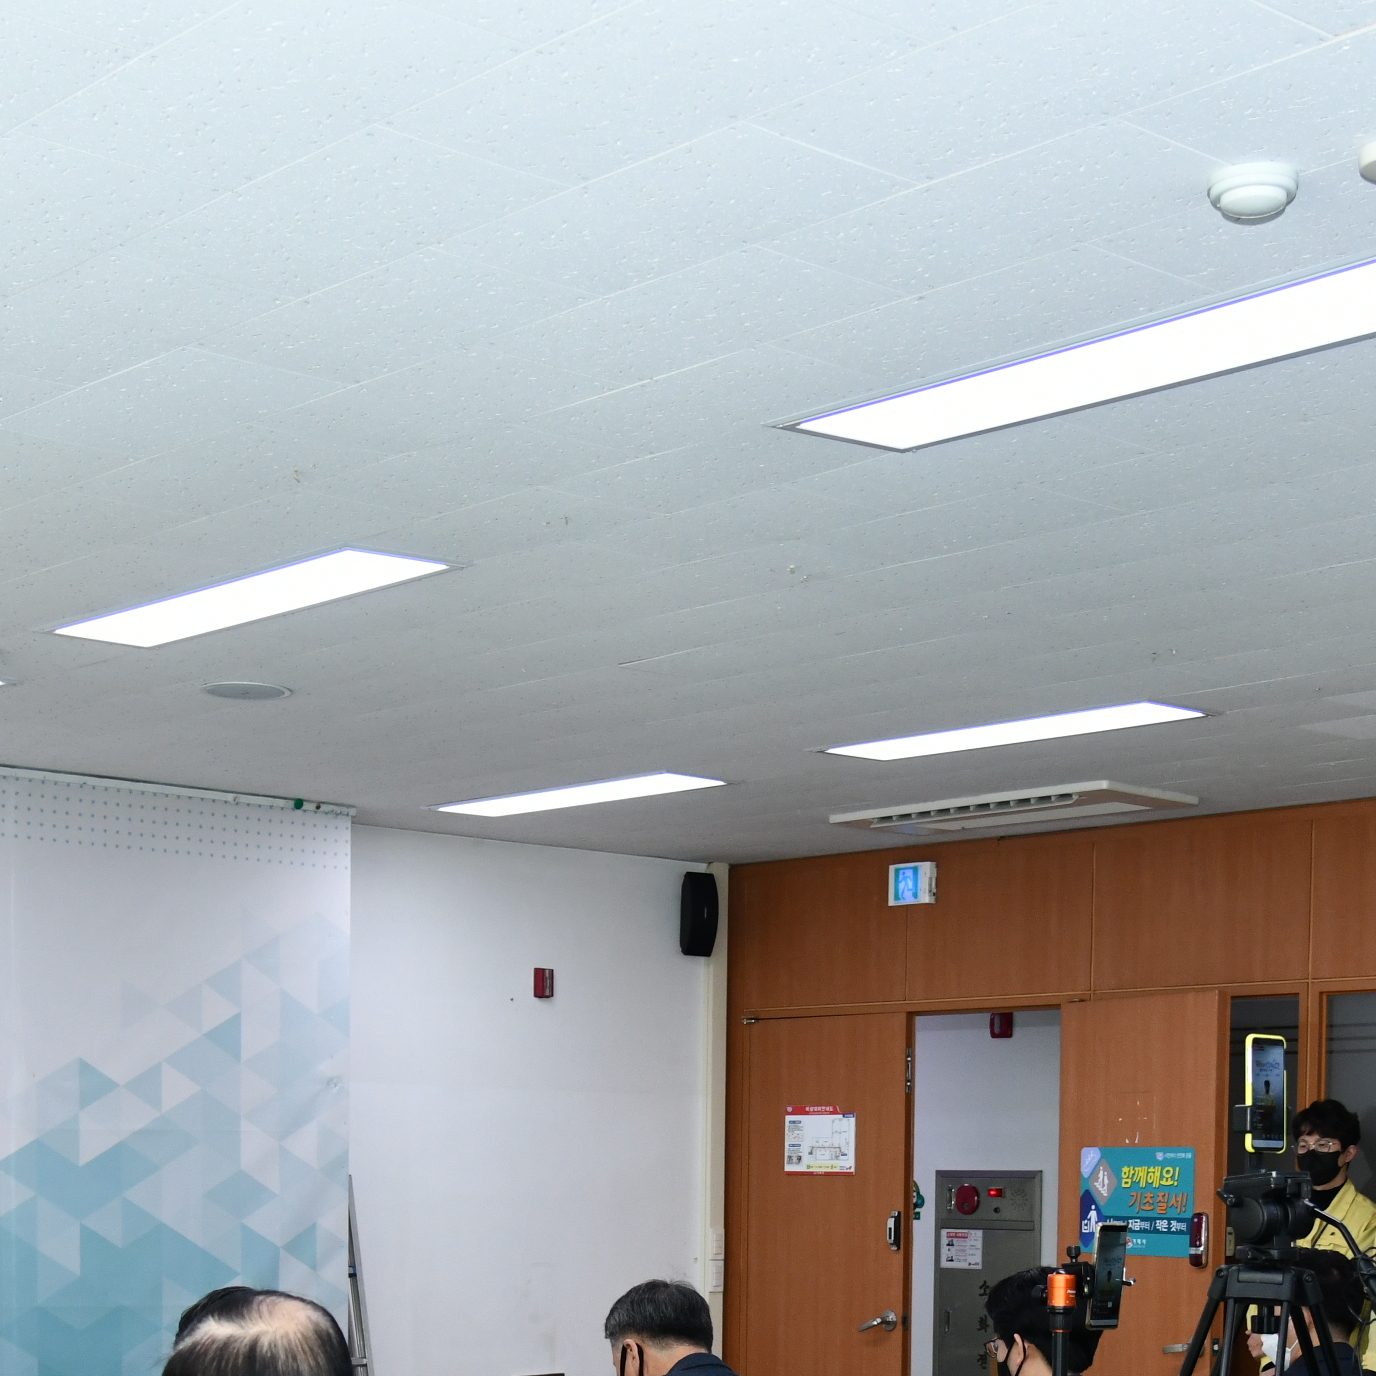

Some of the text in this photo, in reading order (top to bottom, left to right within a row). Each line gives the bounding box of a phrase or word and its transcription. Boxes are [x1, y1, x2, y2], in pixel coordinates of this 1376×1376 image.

[1121, 1166, 1180, 1188] 함께해요!
[1128, 1191, 1189, 1214] 기초질서!
[1128, 1219, 1151, 1231] 지금부터
[1155, 1219, 1168, 1231] 작은
